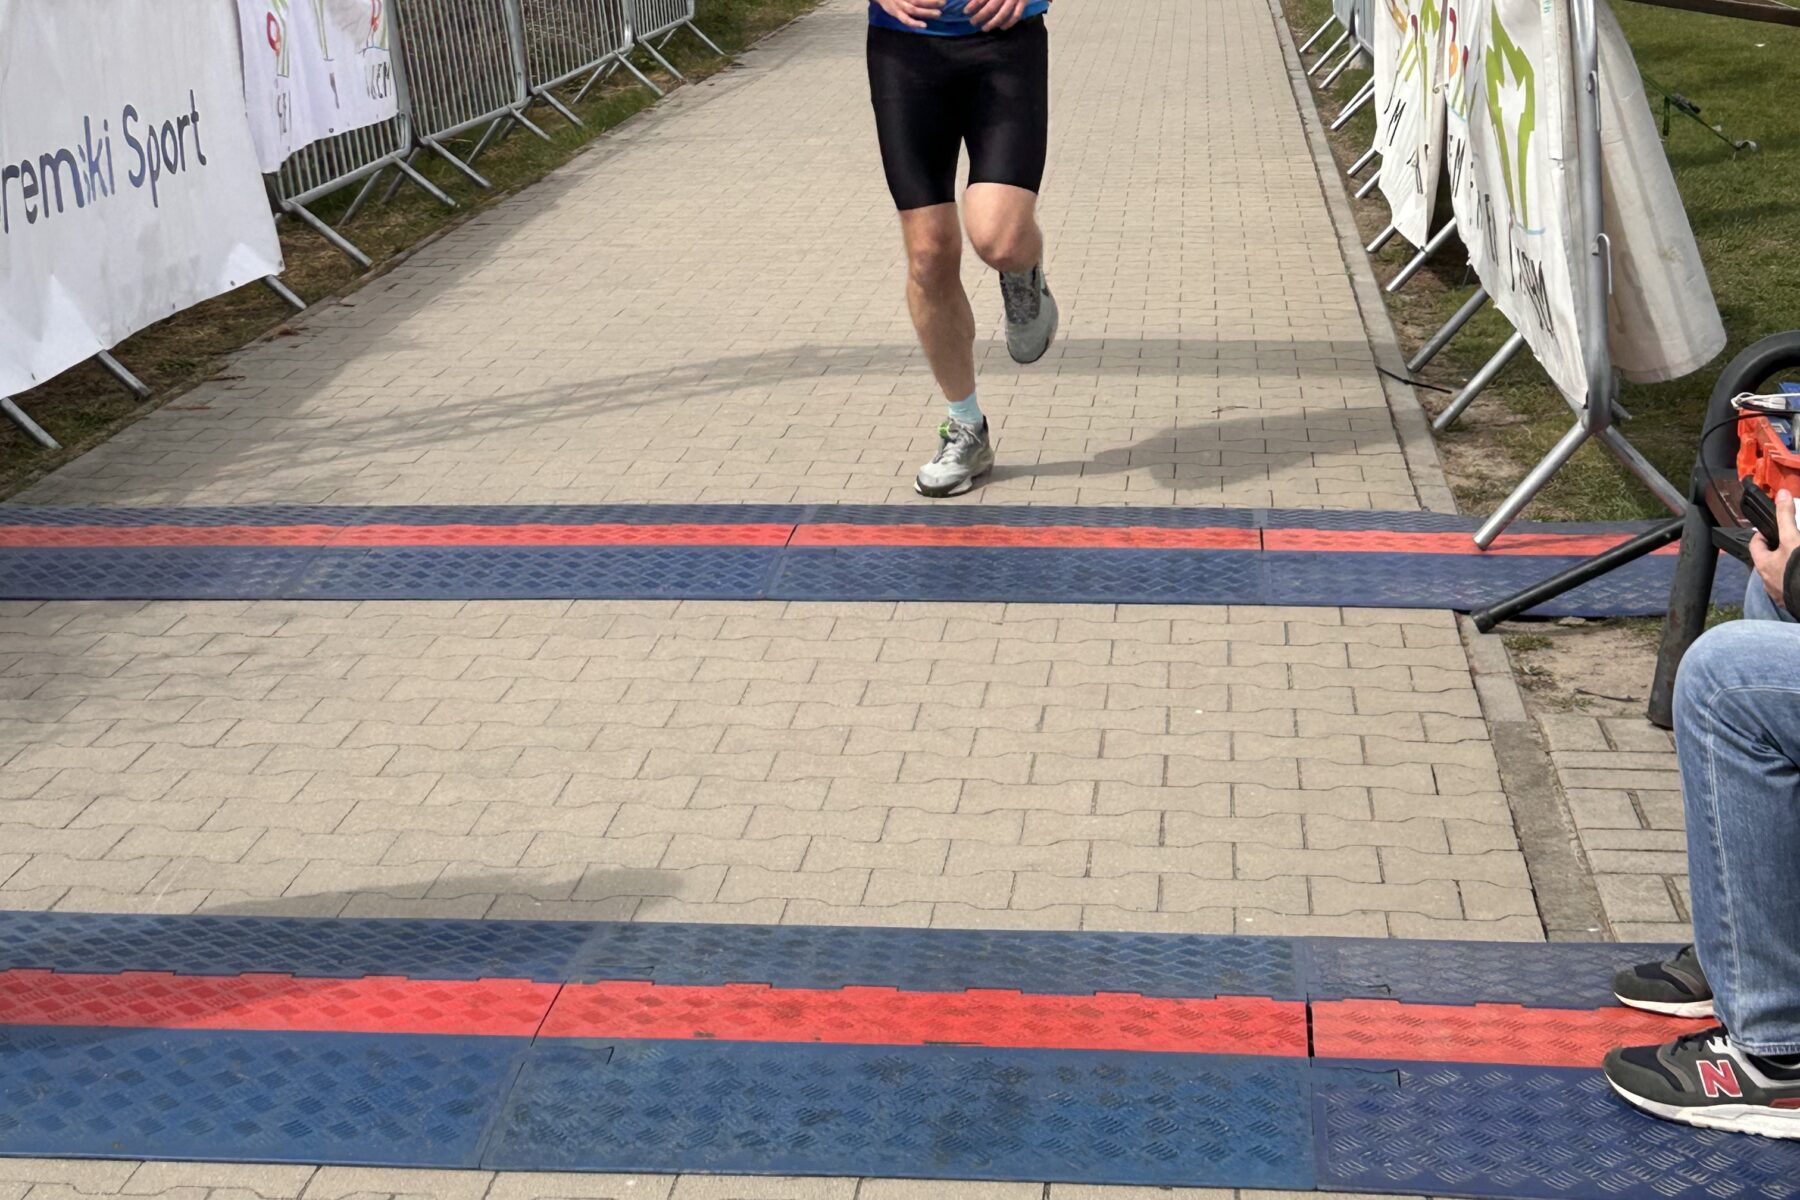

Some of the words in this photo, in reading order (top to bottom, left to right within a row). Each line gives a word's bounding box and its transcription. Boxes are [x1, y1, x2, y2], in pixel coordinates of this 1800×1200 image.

[0, 115, 115, 234] remki
[122, 88, 207, 209] Sport
[1695, 1059, 1743, 1098] N
